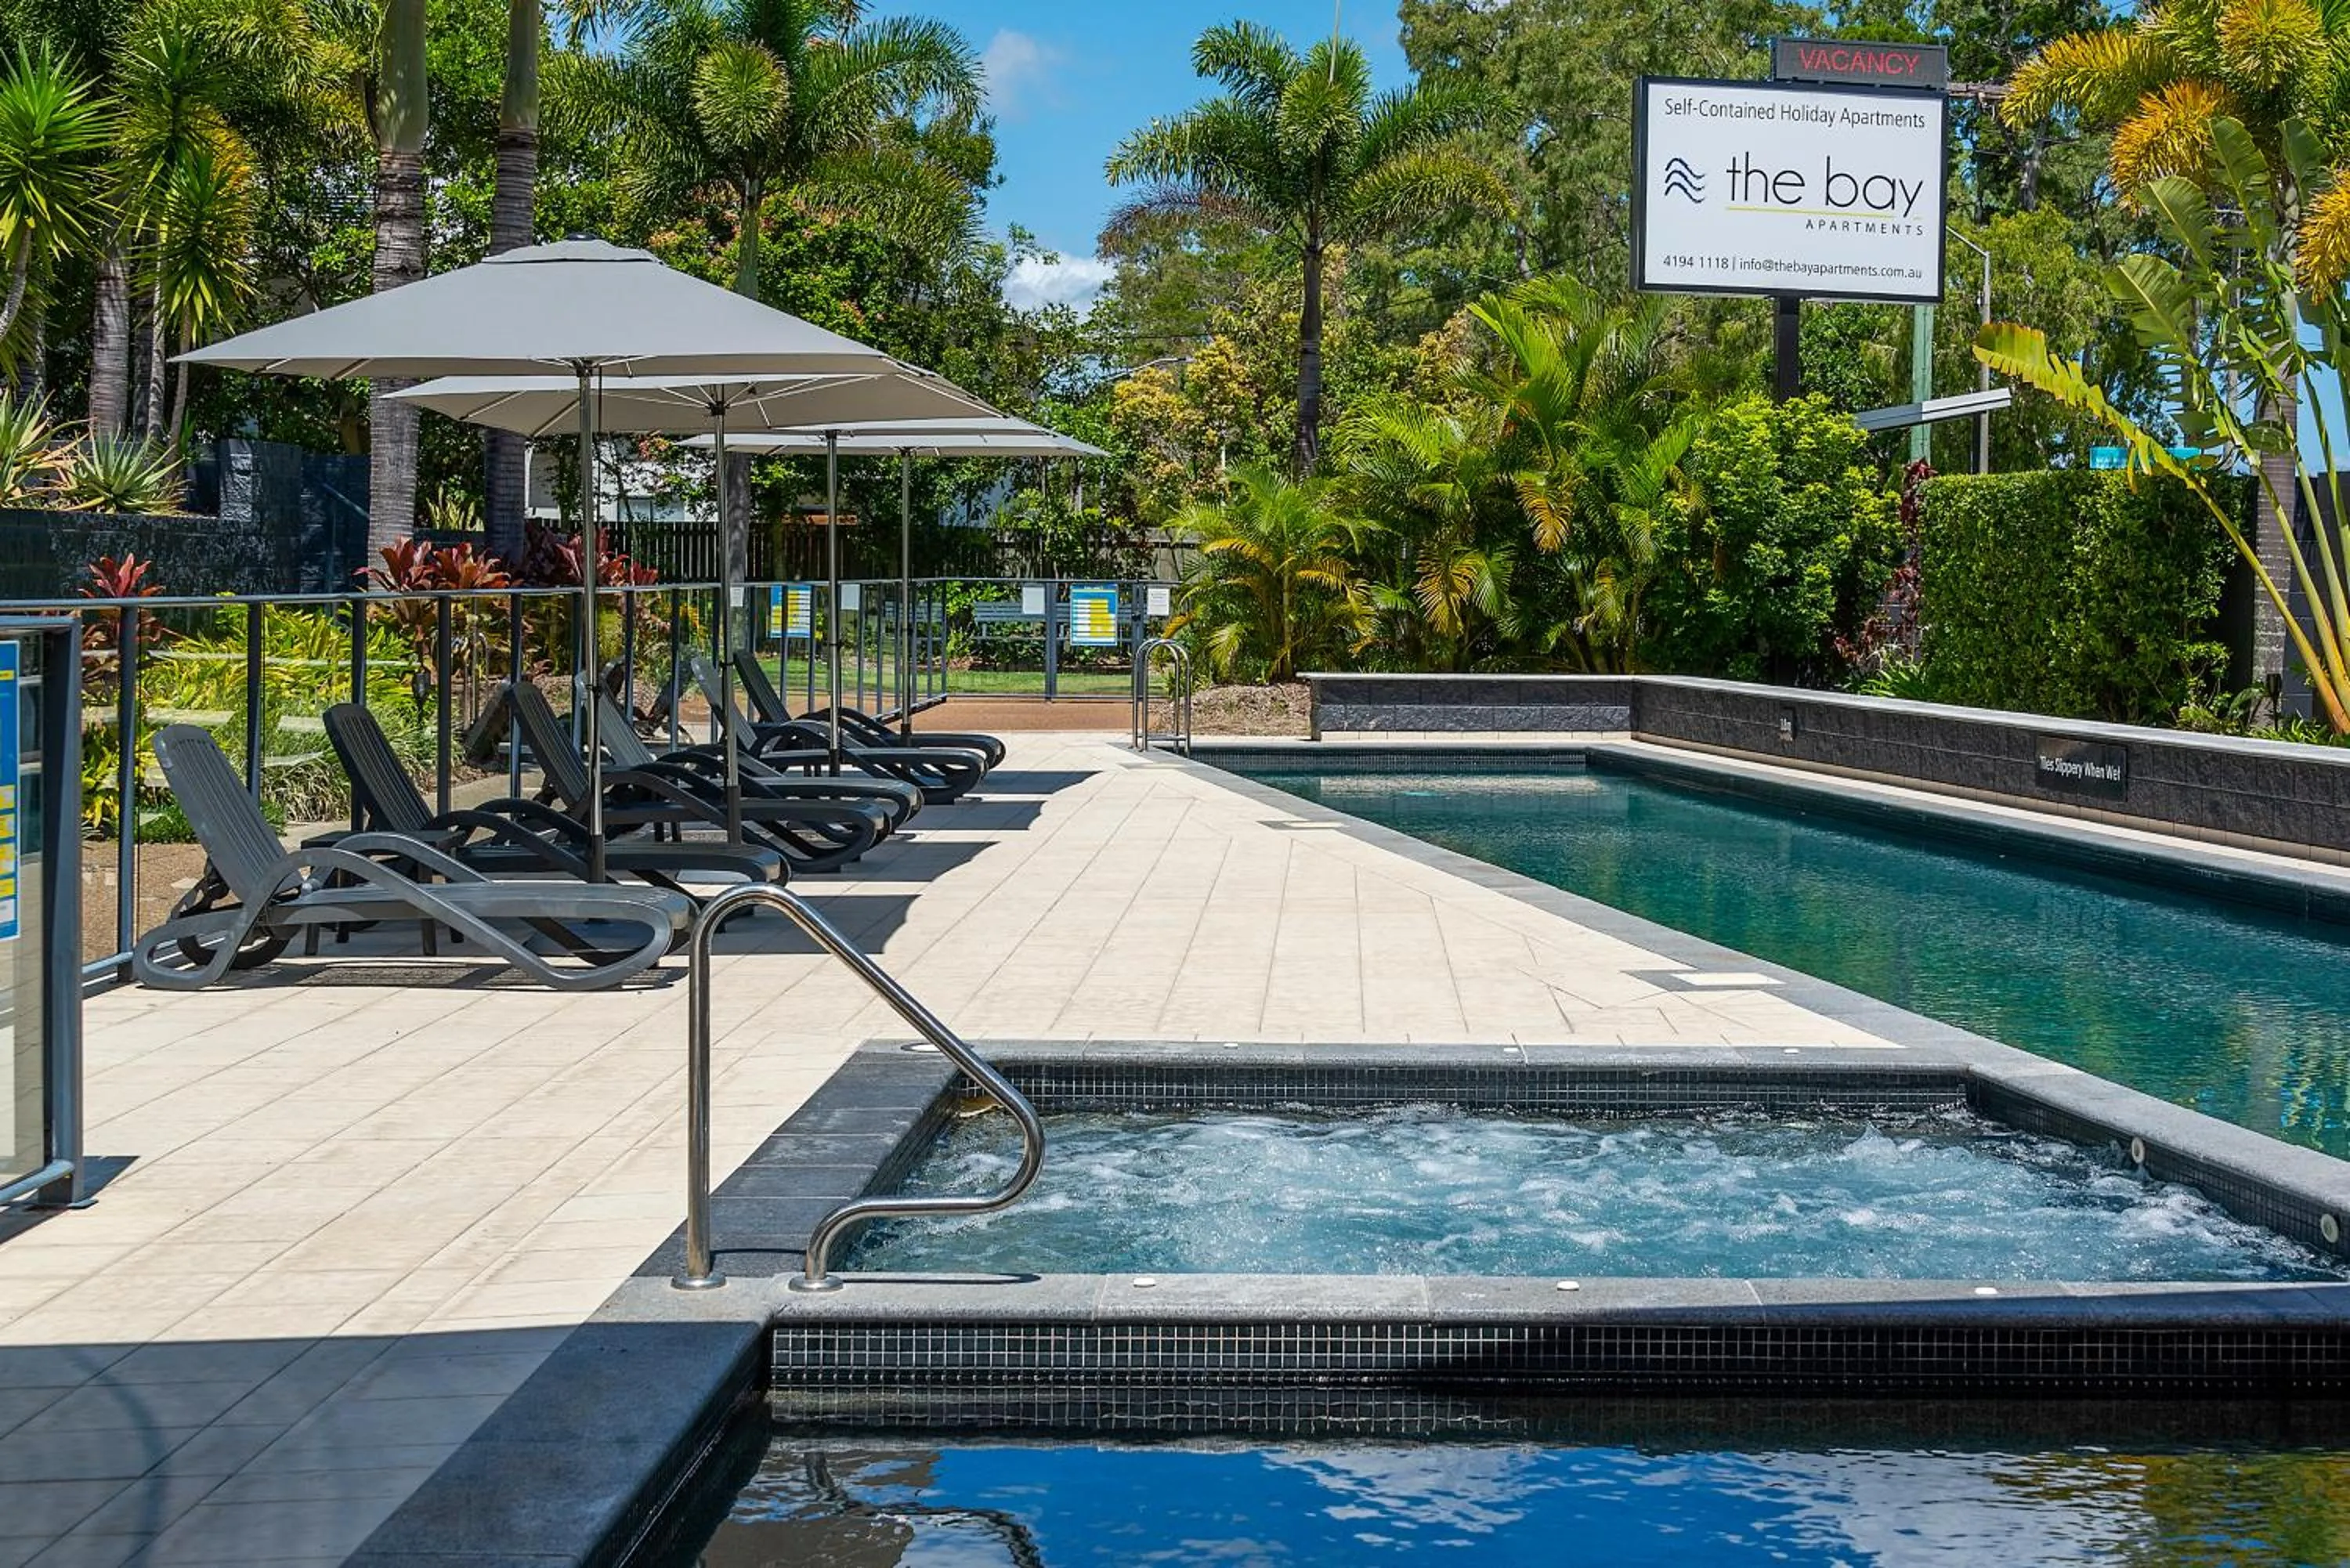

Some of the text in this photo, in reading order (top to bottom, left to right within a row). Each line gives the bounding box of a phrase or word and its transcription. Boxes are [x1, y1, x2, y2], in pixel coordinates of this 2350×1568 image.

[1799, 49, 1919, 75] VACANCY
[1665, 98, 1925, 128] Self-Contained Holiday Apartments
[1726, 151, 1924, 218] the bay
[1806, 219, 1924, 236] APARTMENTS
[1663, 255, 1694, 268] 4194
[1700, 256, 1730, 269] 1118
[1739, 258, 1922, 279] info@thebayapartments.com.au
[2055, 757, 2084, 779] Slippery
[2084, 762, 2105, 779] When
